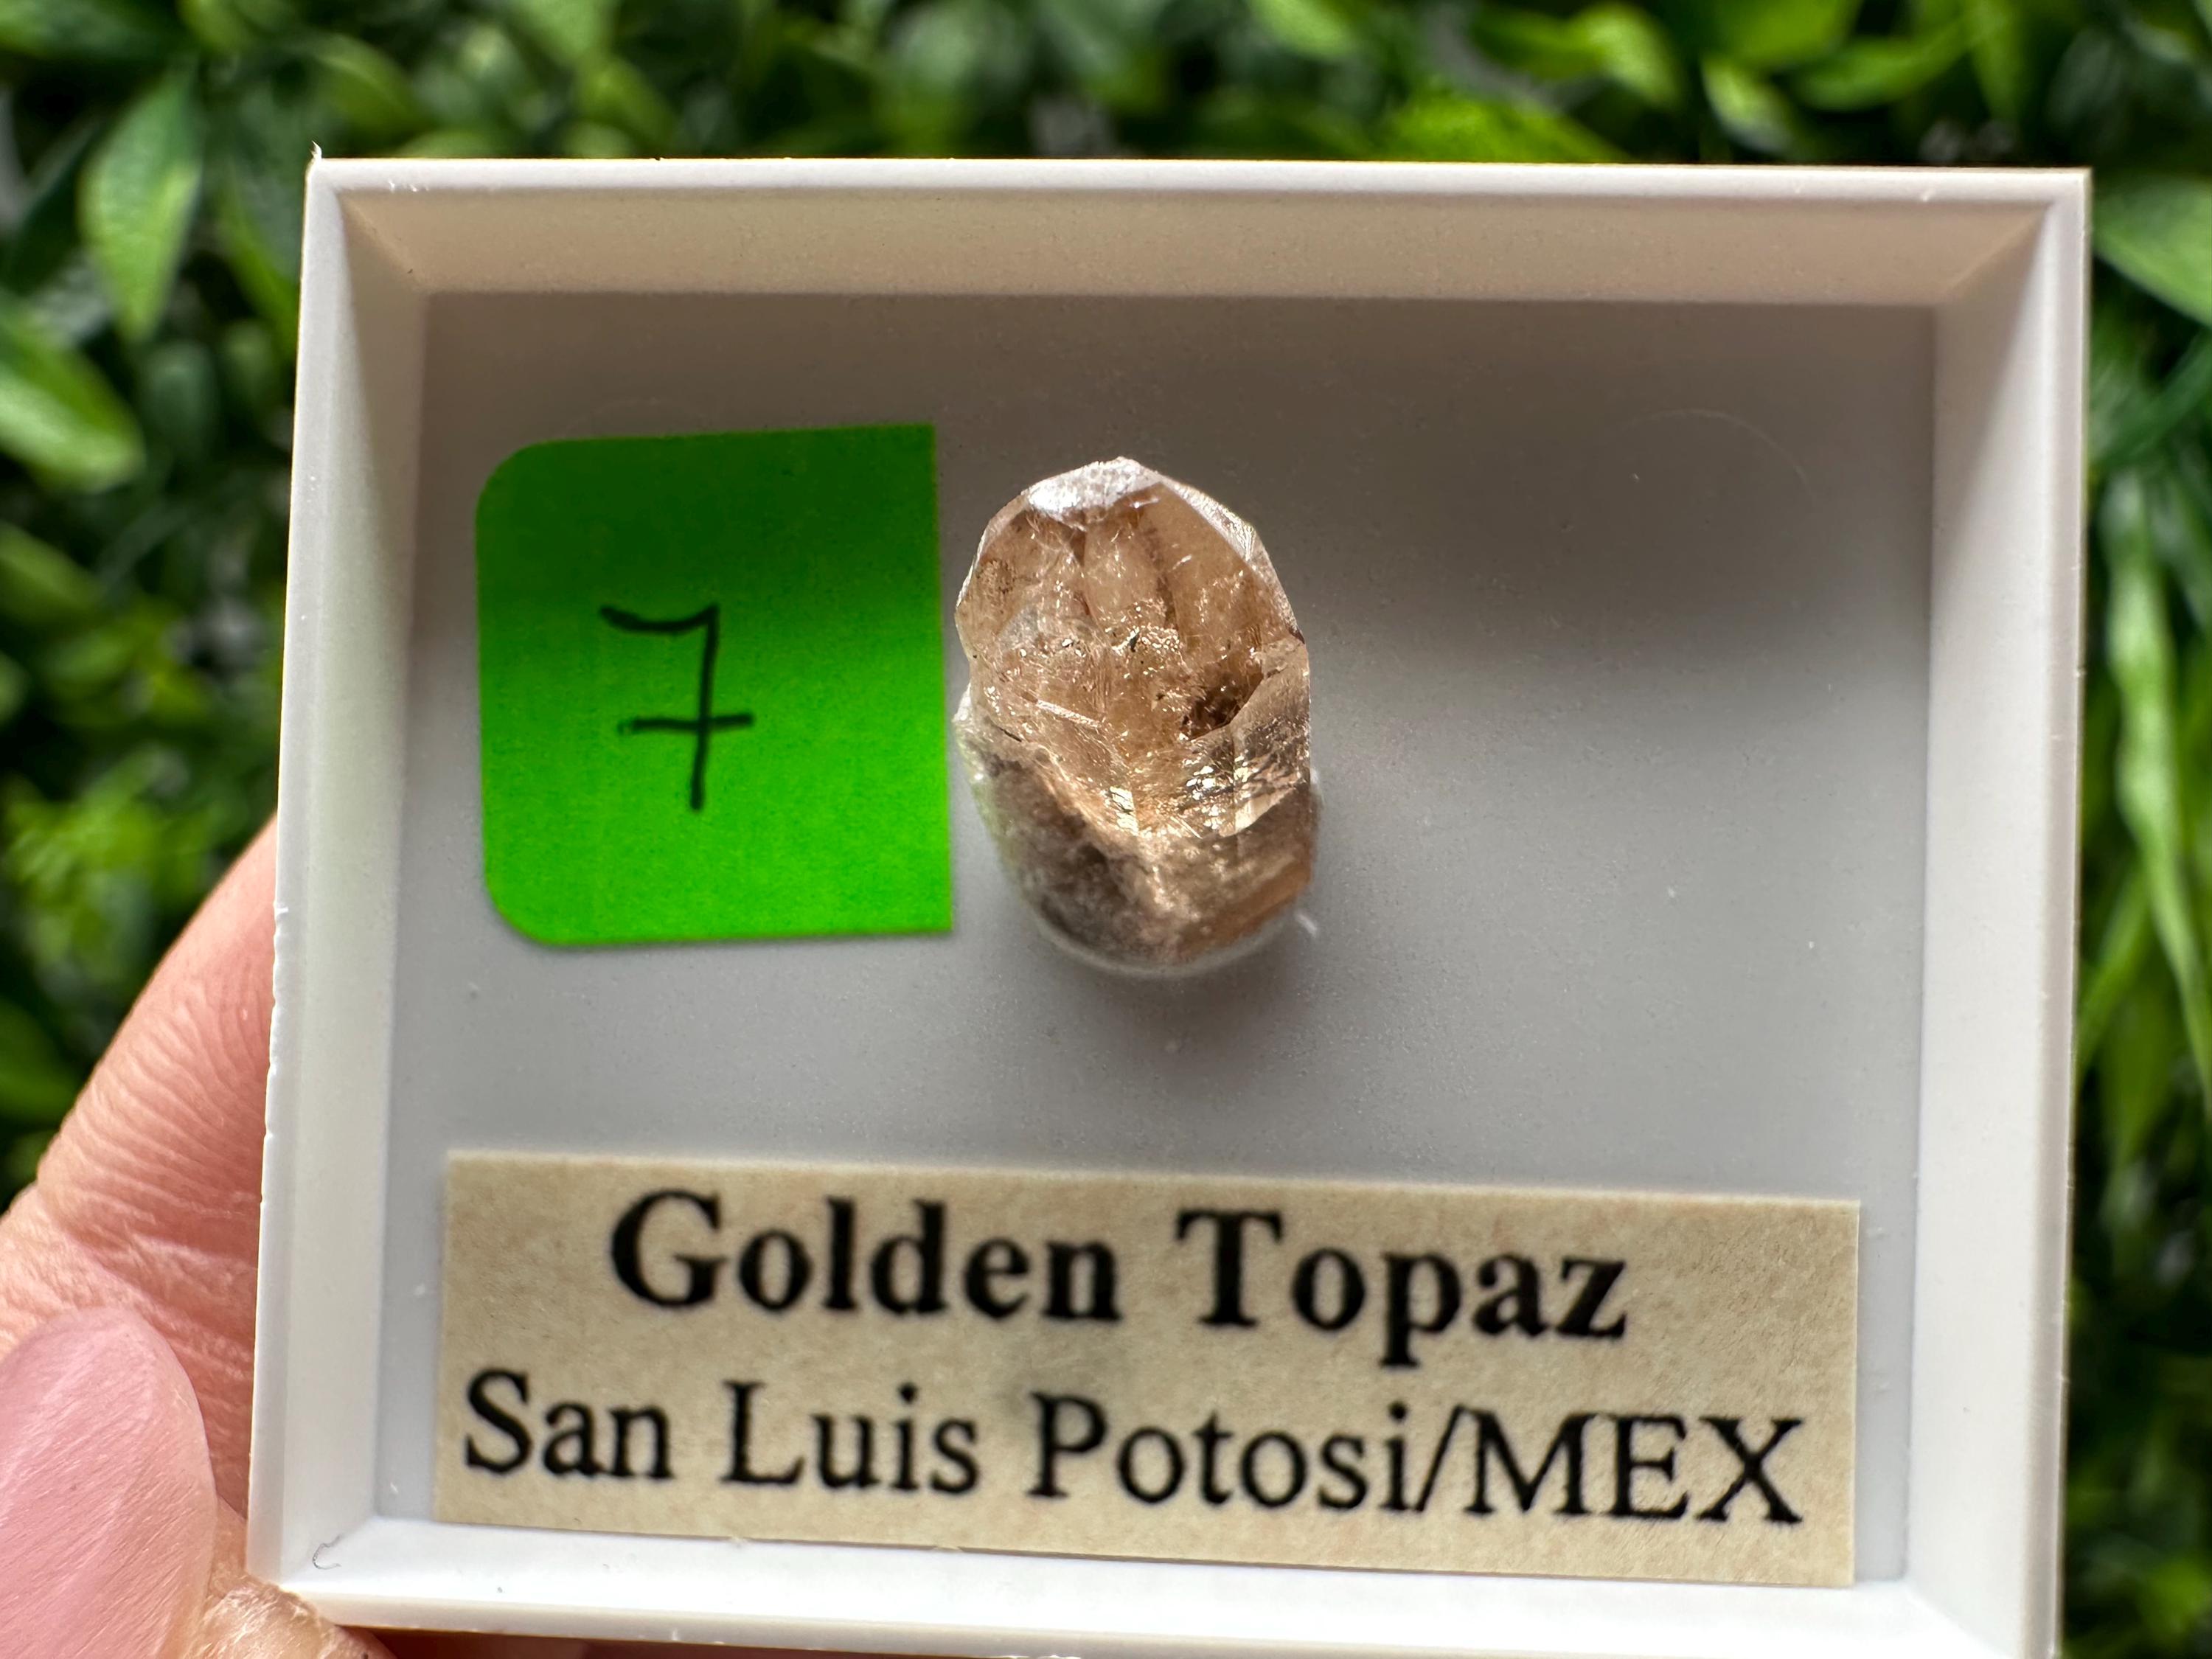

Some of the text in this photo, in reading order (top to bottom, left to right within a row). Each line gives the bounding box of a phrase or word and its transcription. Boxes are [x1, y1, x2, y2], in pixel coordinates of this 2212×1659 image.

[600, 602, 755, 812] 7
[608, 1186, 1628, 1371] Golden Topaz
[465, 1366, 1804, 1526] San Luis Potosi/MEX
